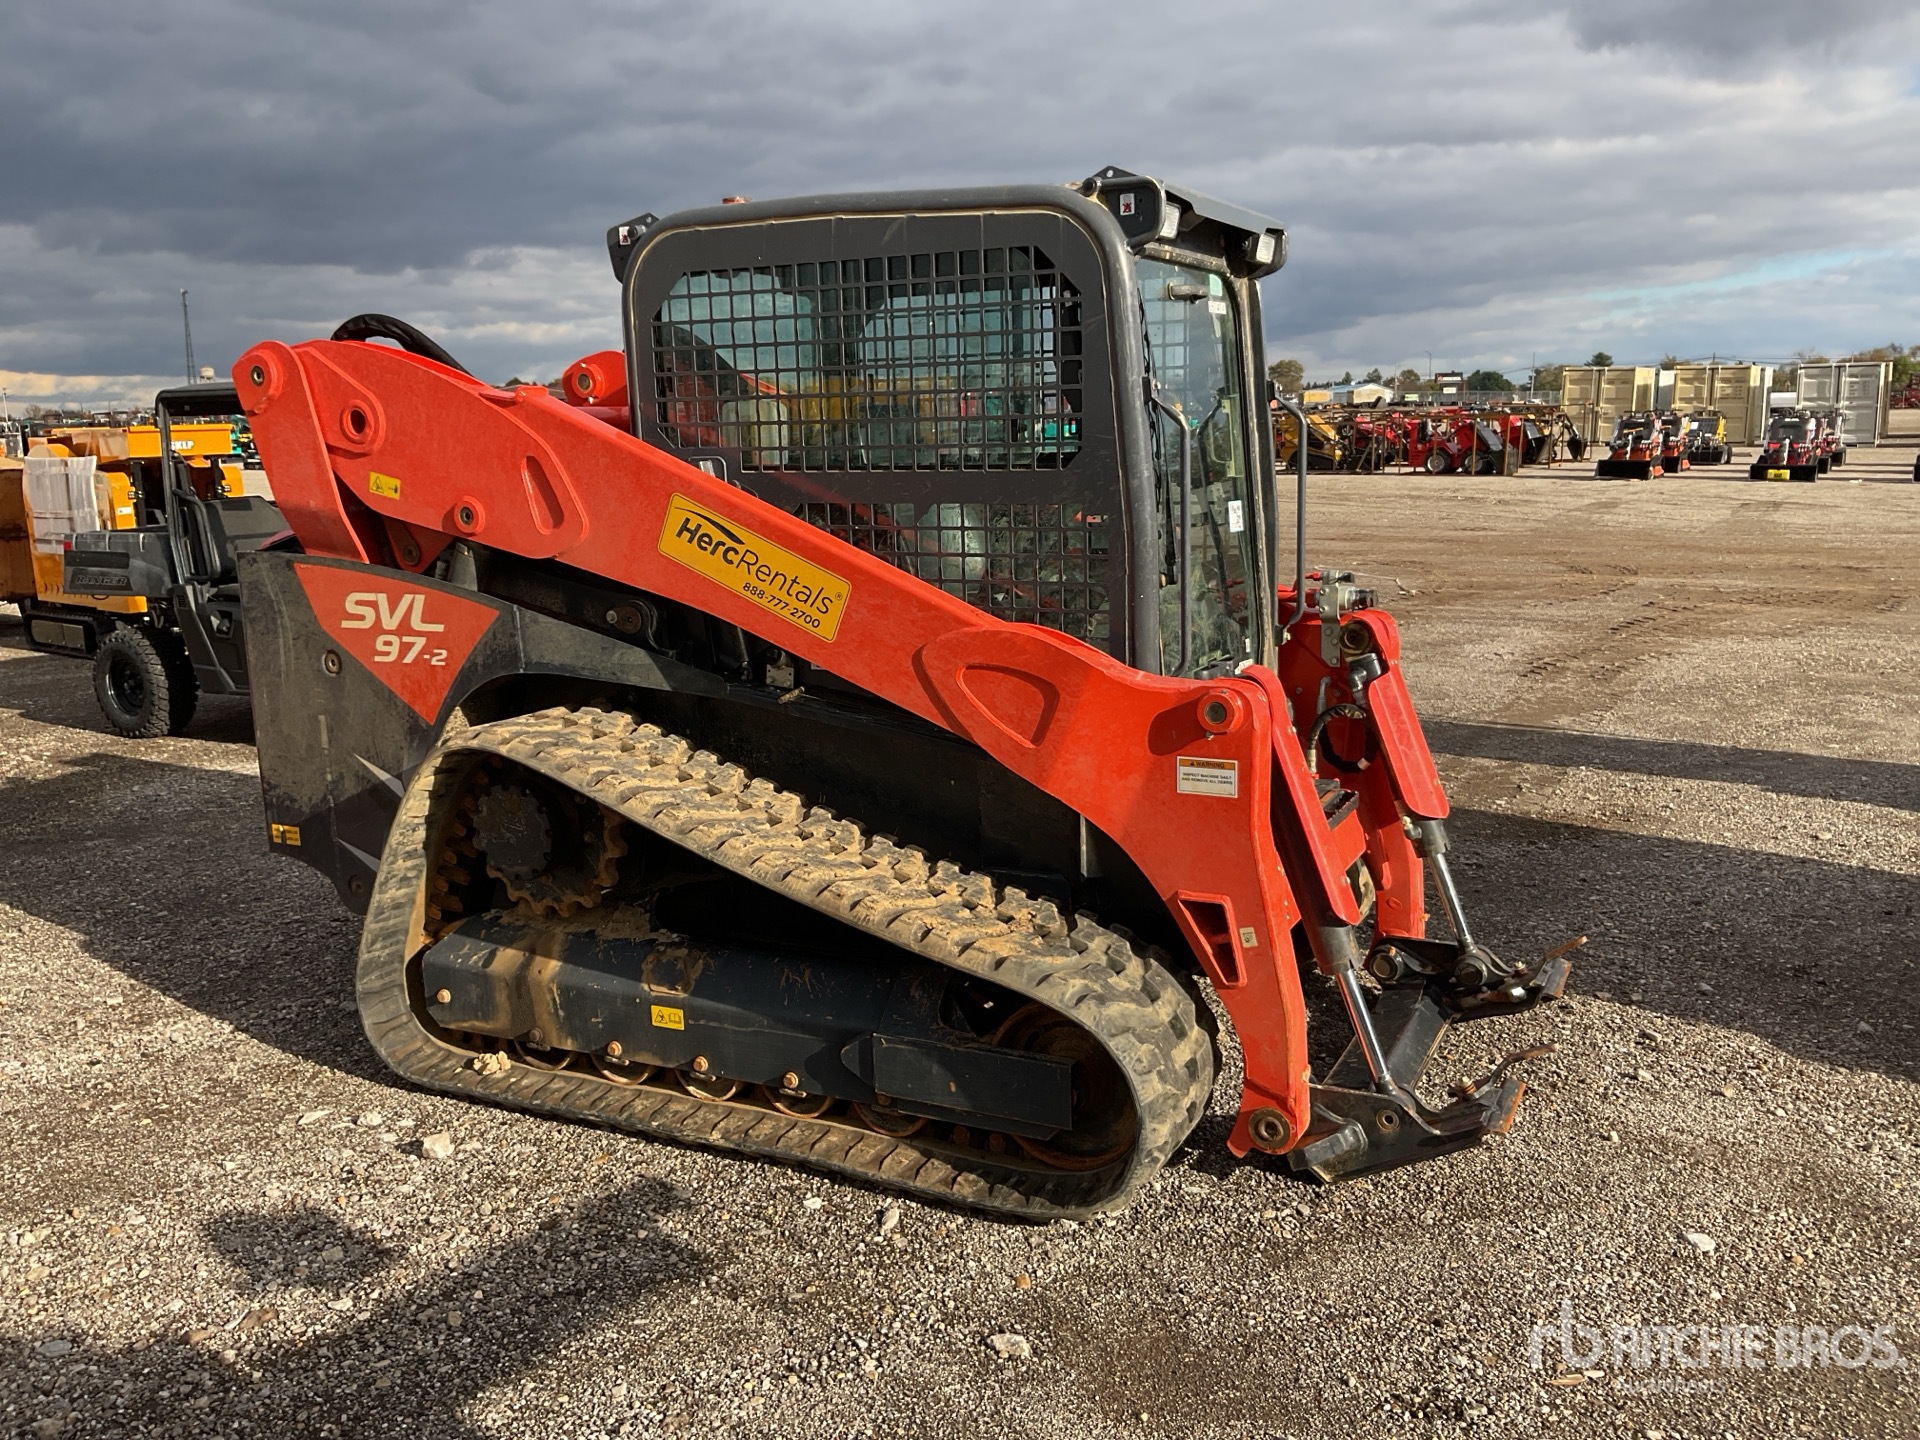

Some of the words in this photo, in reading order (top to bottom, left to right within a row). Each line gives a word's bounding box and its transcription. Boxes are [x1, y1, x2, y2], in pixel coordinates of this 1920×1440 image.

[76, 575, 127, 587] RANGER
[340, 592, 445, 632] SVL
[742, 581, 821, 629] 888-777-2700
[373, 634, 448, 666] 97-2
[1195, 761, 1225, 769] WARNING
